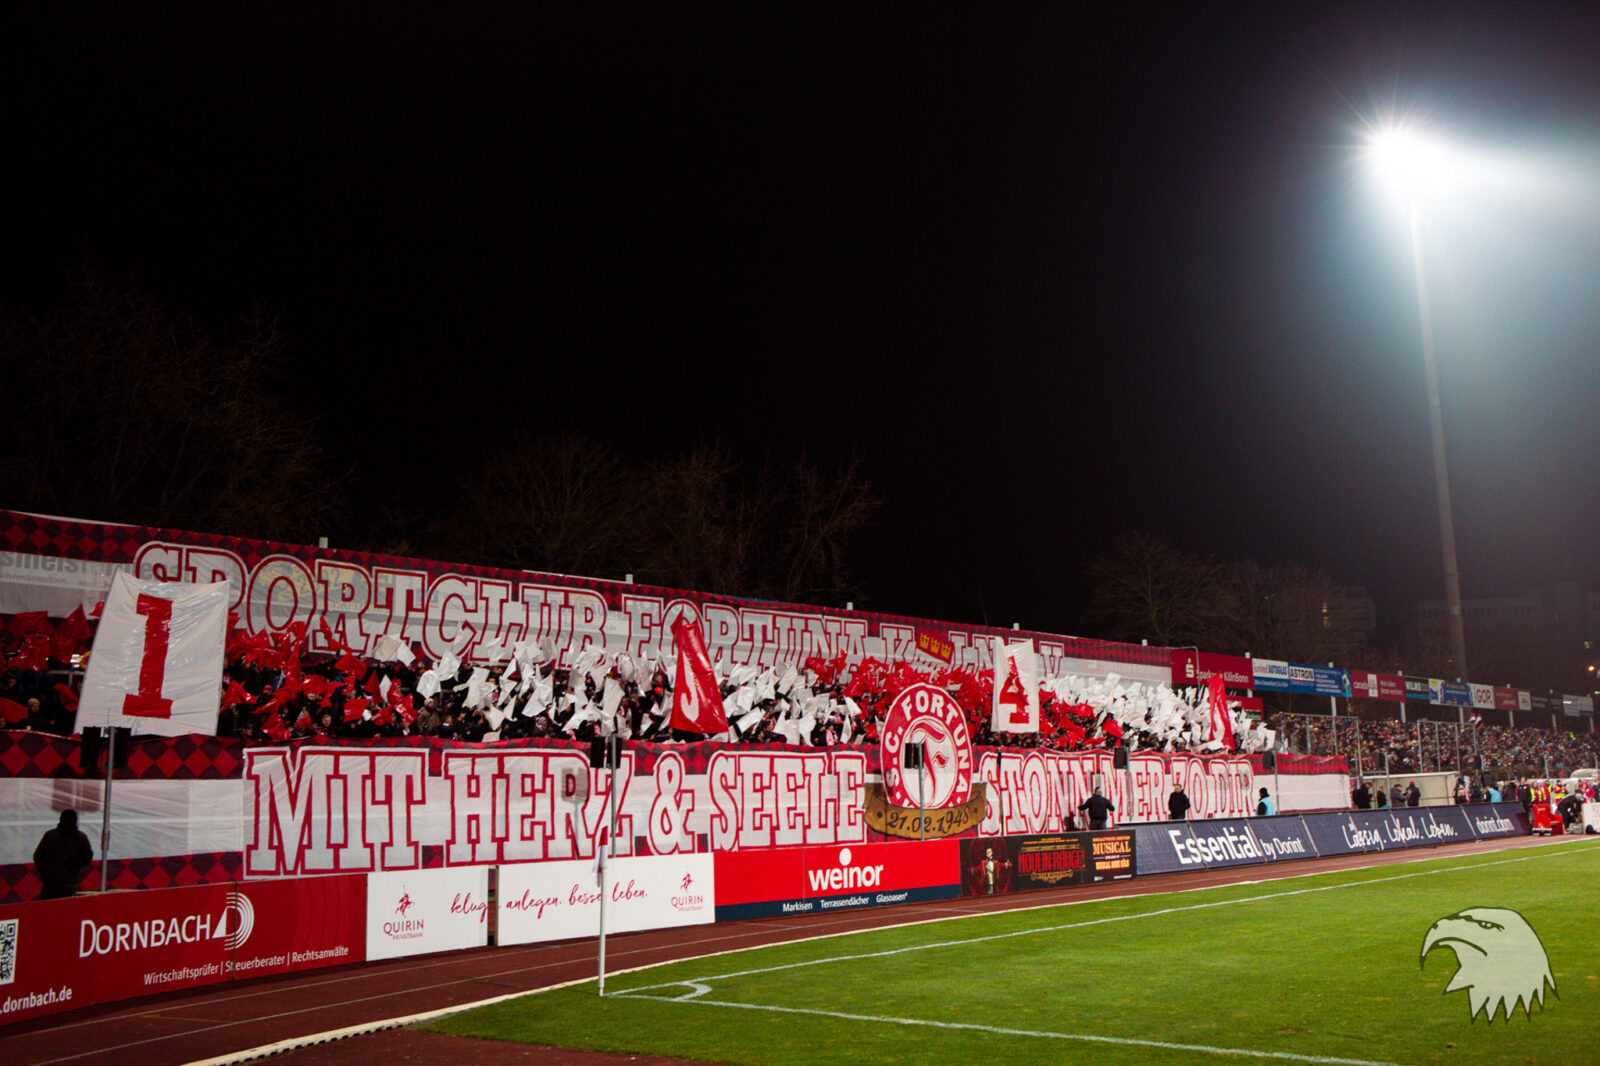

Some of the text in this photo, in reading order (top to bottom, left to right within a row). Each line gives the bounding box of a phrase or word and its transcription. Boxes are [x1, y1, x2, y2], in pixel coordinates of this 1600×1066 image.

[901, 689, 970, 793] FORTUNA
[243, 746, 430, 880] MIT
[442, 749, 636, 867] HERZ
[649, 750, 697, 857] &
[708, 750, 868, 852] SEELE
[978, 752, 1097, 837] STONN
[1209, 759, 1255, 818] DIR
[1017, 851, 1052, 874] MOULIN
[1053, 848, 1086, 872] ROUGE!
[1092, 840, 1132, 855] MUSICAL
[1168, 825, 1306, 865] Essential by Dorint
[808, 847, 884, 892] weinor
[612, 878, 649, 902] leben.
[670, 895, 704, 909] QUIRIN
[782, 901, 814, 913] Markisen
[820, 896, 870, 909] Terrassendächer
[79, 913, 211, 959] DORNBACH
[383, 918, 425, 936] QUIRIN
[143, 945, 349, 986] Wirtschaftsprüfer Steuerberater Rechtsanwälte
